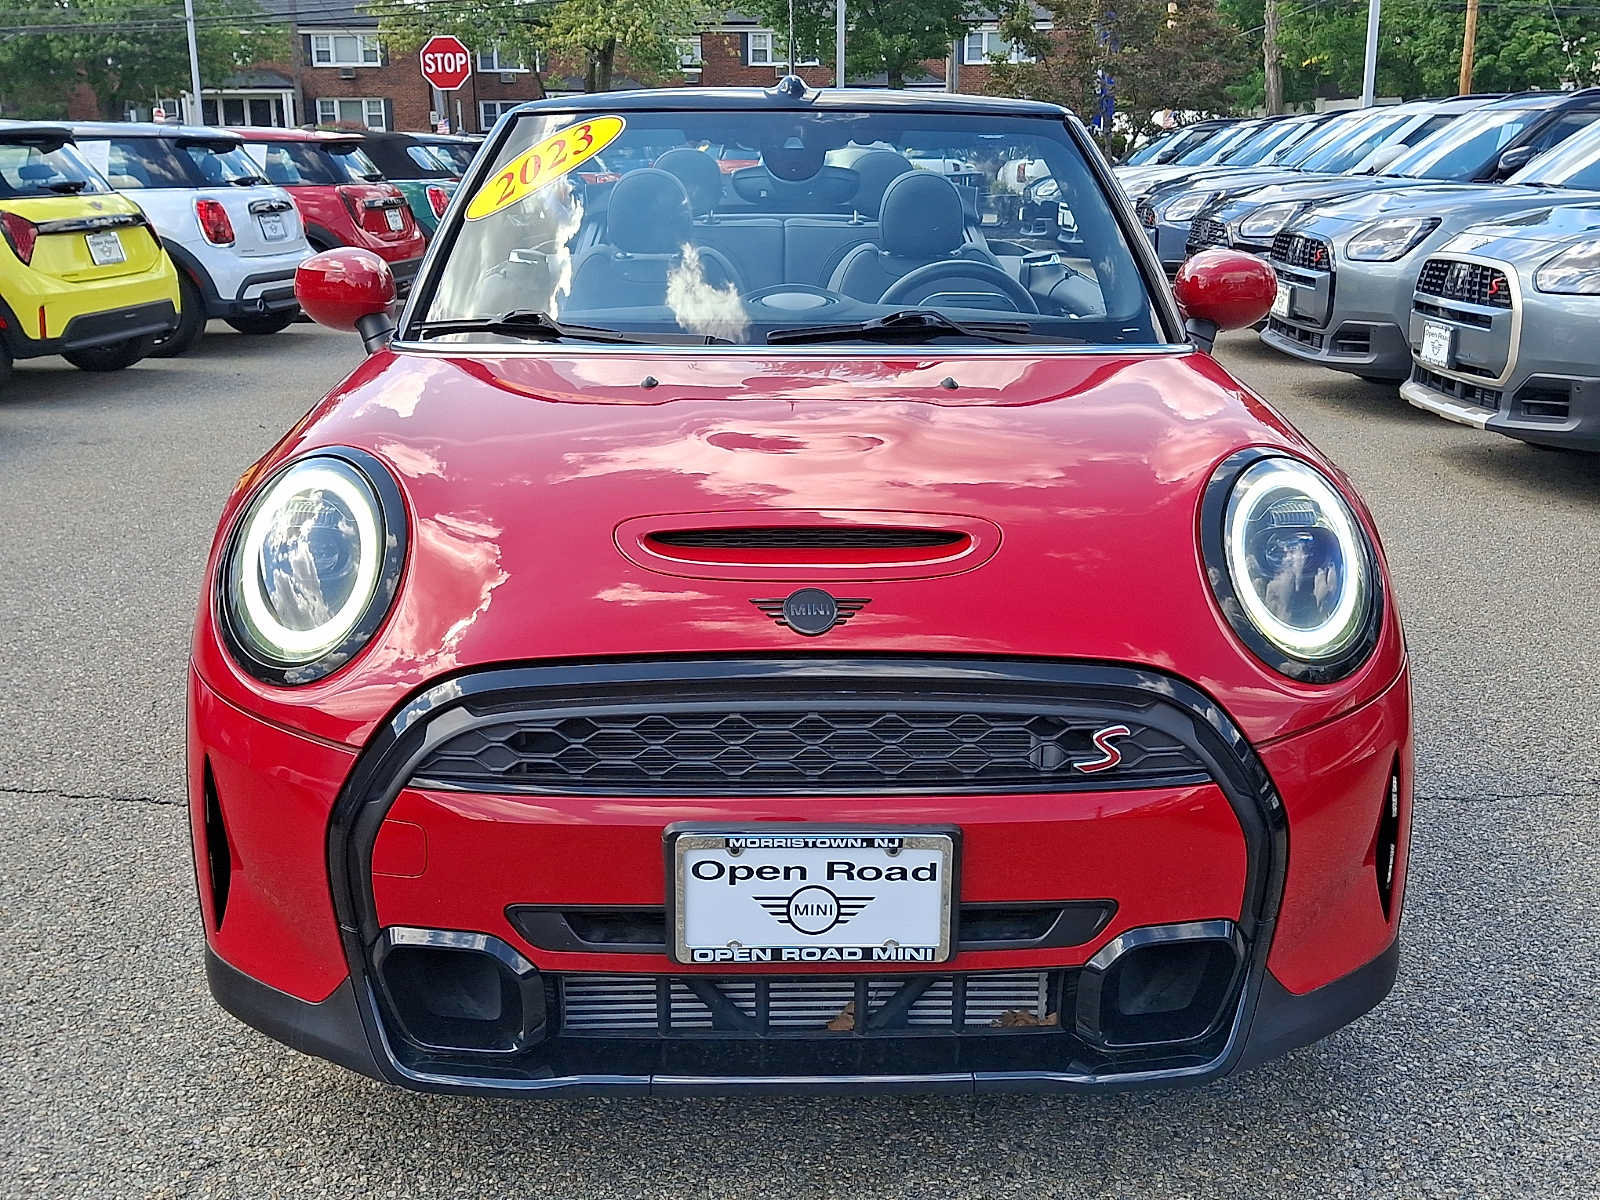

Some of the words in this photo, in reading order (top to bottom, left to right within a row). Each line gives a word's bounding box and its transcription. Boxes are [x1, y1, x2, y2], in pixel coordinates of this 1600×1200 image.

[424, 53, 467, 74] STOP
[495, 124, 594, 206] 2023
[1488, 276, 1507, 295] S
[790, 602, 831, 616] MINI
[1073, 724, 1131, 774] S
[728, 838, 867, 849] MORRISTOWN,
[874, 838, 900, 848] NJ
[691, 860, 807, 886] Open
[826, 861, 937, 881] Road
[794, 903, 833, 917] MINI
[693, 947, 777, 962] OPEN
[782, 947, 863, 961] ROAD
[873, 947, 933, 961] MINI
